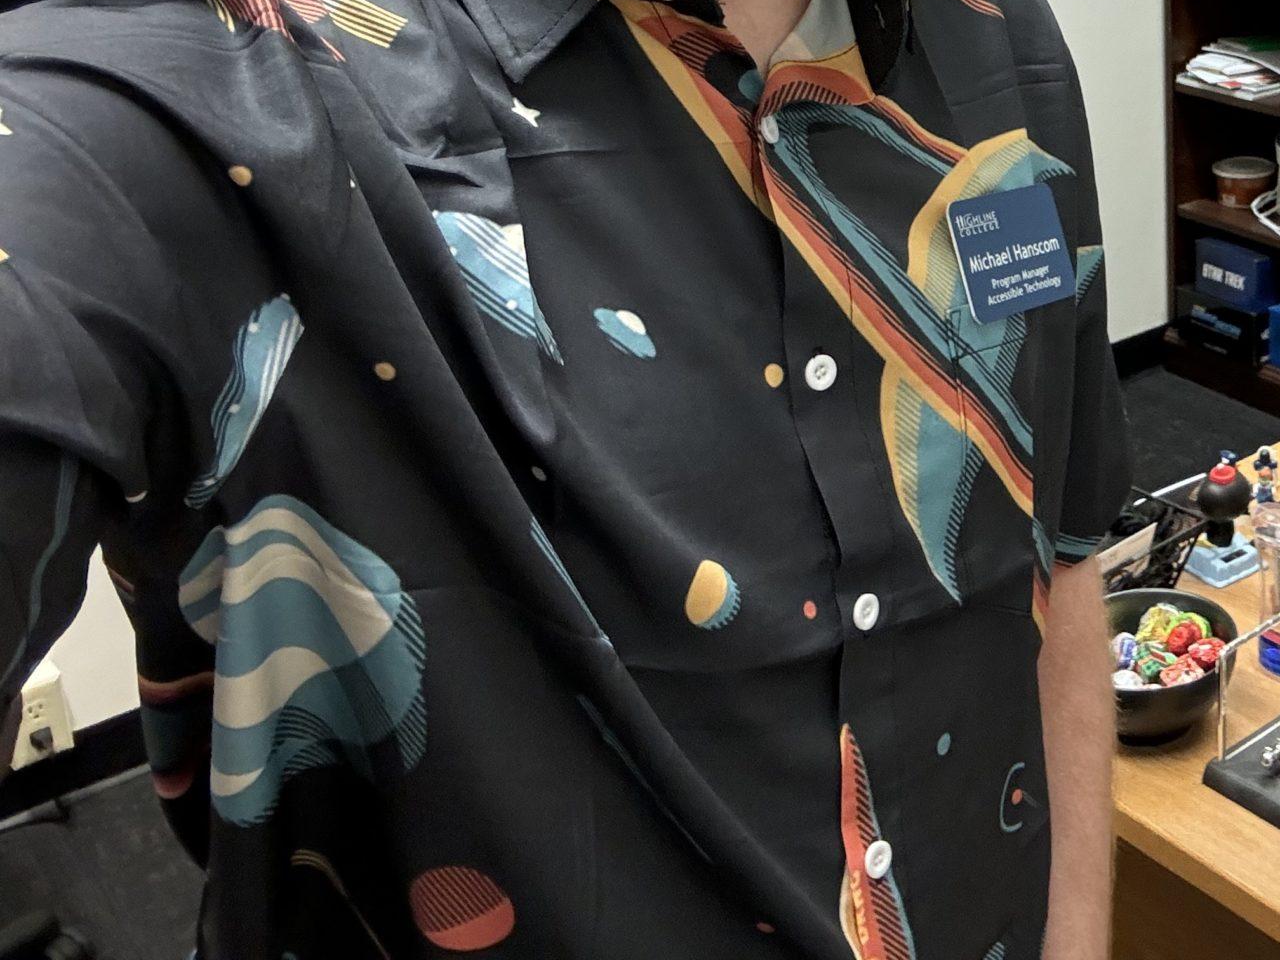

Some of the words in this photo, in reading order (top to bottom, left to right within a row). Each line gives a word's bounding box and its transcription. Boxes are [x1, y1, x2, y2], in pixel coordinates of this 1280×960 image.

[960, 221, 1000, 237] COLLEGE
[969, 247, 1012, 274] Michael
[1012, 237, 1060, 261] Hanscom
[991, 274, 1021, 289] Program
[1021, 265, 1049, 280] Manager
[988, 288, 1024, 306] Accessible
[1023, 276, 1061, 293] Technology
